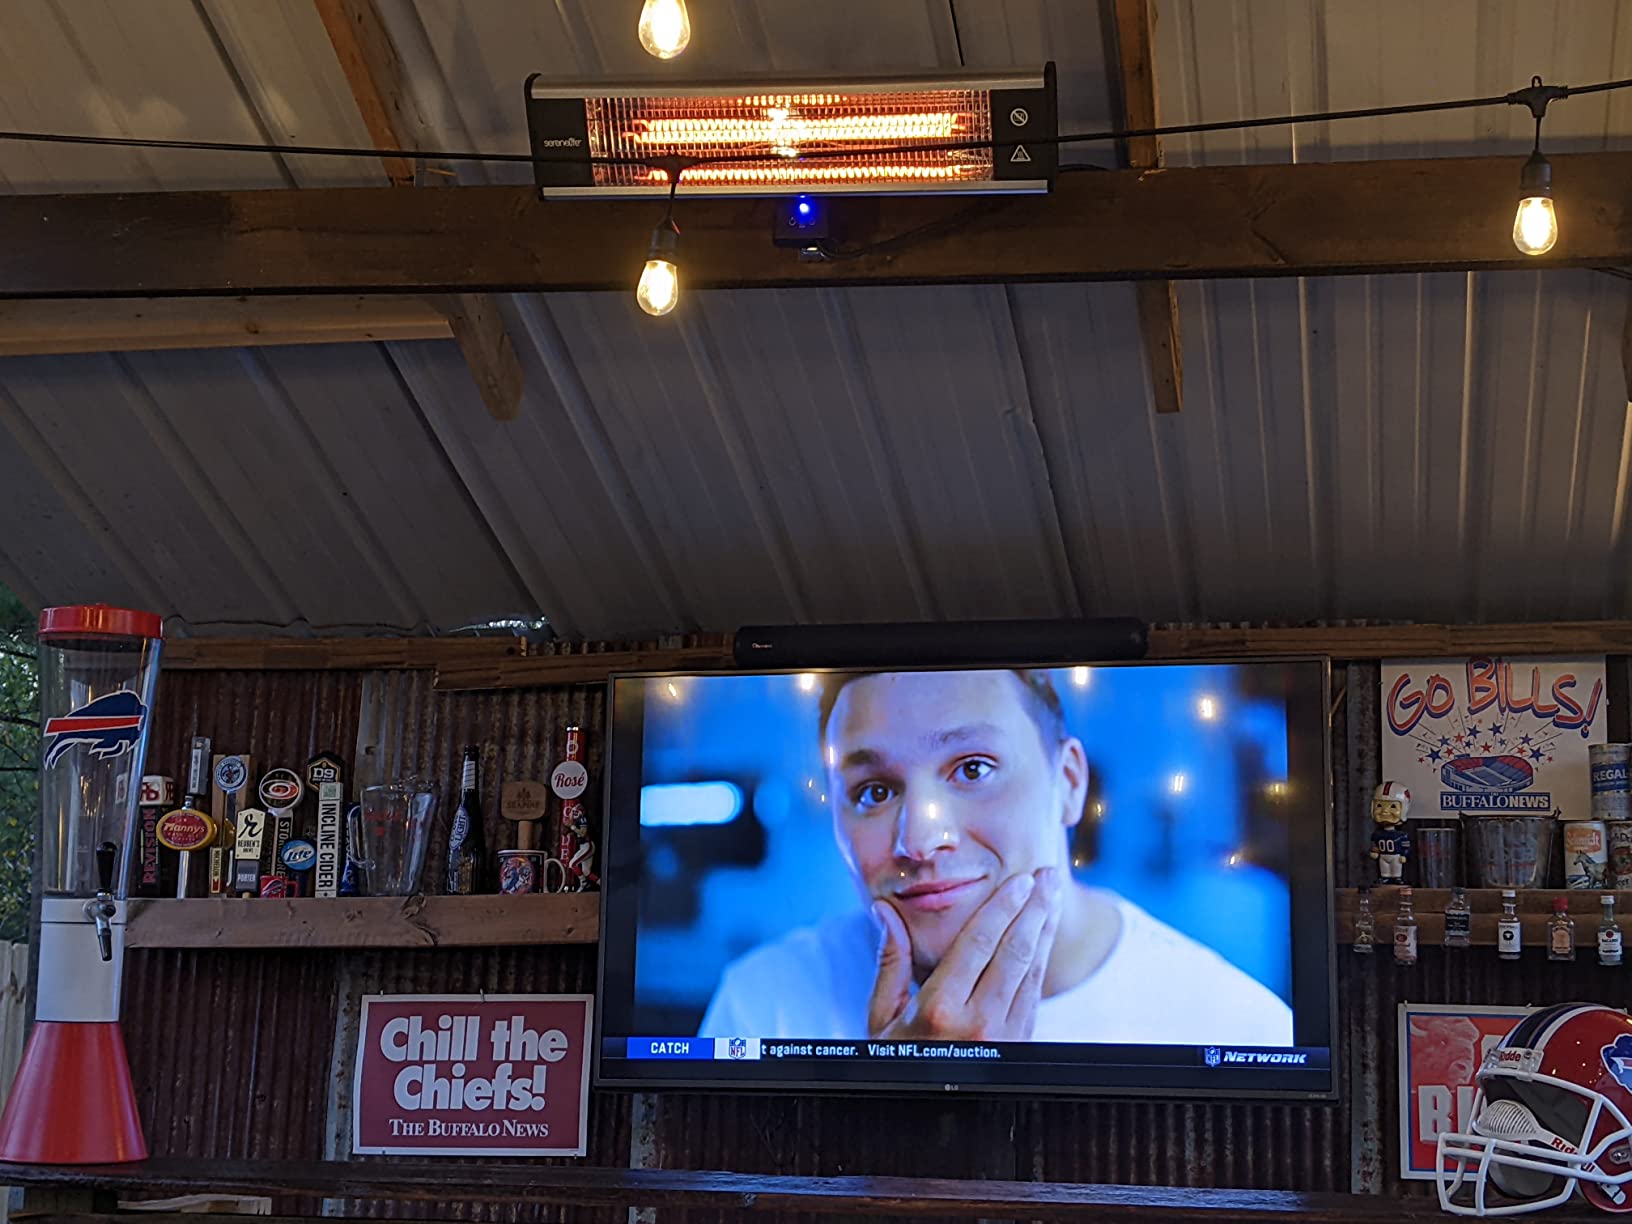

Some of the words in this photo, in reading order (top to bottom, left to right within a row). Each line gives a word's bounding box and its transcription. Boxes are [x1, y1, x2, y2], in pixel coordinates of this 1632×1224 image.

[1386, 672, 1455, 736] GO
[1466, 656, 1603, 738] BILLS!
[313, 767, 334, 779] D9
[554, 771, 586, 789] Rosé
[1593, 768, 1629, 783] REGAL
[1442, 795, 1508, 808] BUFFALO
[1508, 796, 1549, 809] NEWS
[320, 803, 336, 850] INCLINE
[454, 814, 467, 842] LIGHT
[143, 808, 156, 883] REVISION
[287, 849, 312, 862] Lite
[318, 851, 335, 891] CIDER
[380, 1015, 480, 1062] Chill
[490, 1015, 569, 1062] the
[650, 1042, 690, 1055] CATCH
[731, 1046, 745, 1057] NFL
[769, 1044, 813, 1058] against
[815, 1046, 859, 1057] cancer.
[868, 1044, 895, 1057] Visit
[898, 1044, 1001, 1059] NFL.com/auction.
[1223, 1051, 1307, 1064] NETWORK
[393, 1063, 547, 1111] Chiefs!
[389, 1119, 425, 1137] THE
[428, 1119, 500, 1137] BUFFALO
[502, 1120, 549, 1138] NEWS
